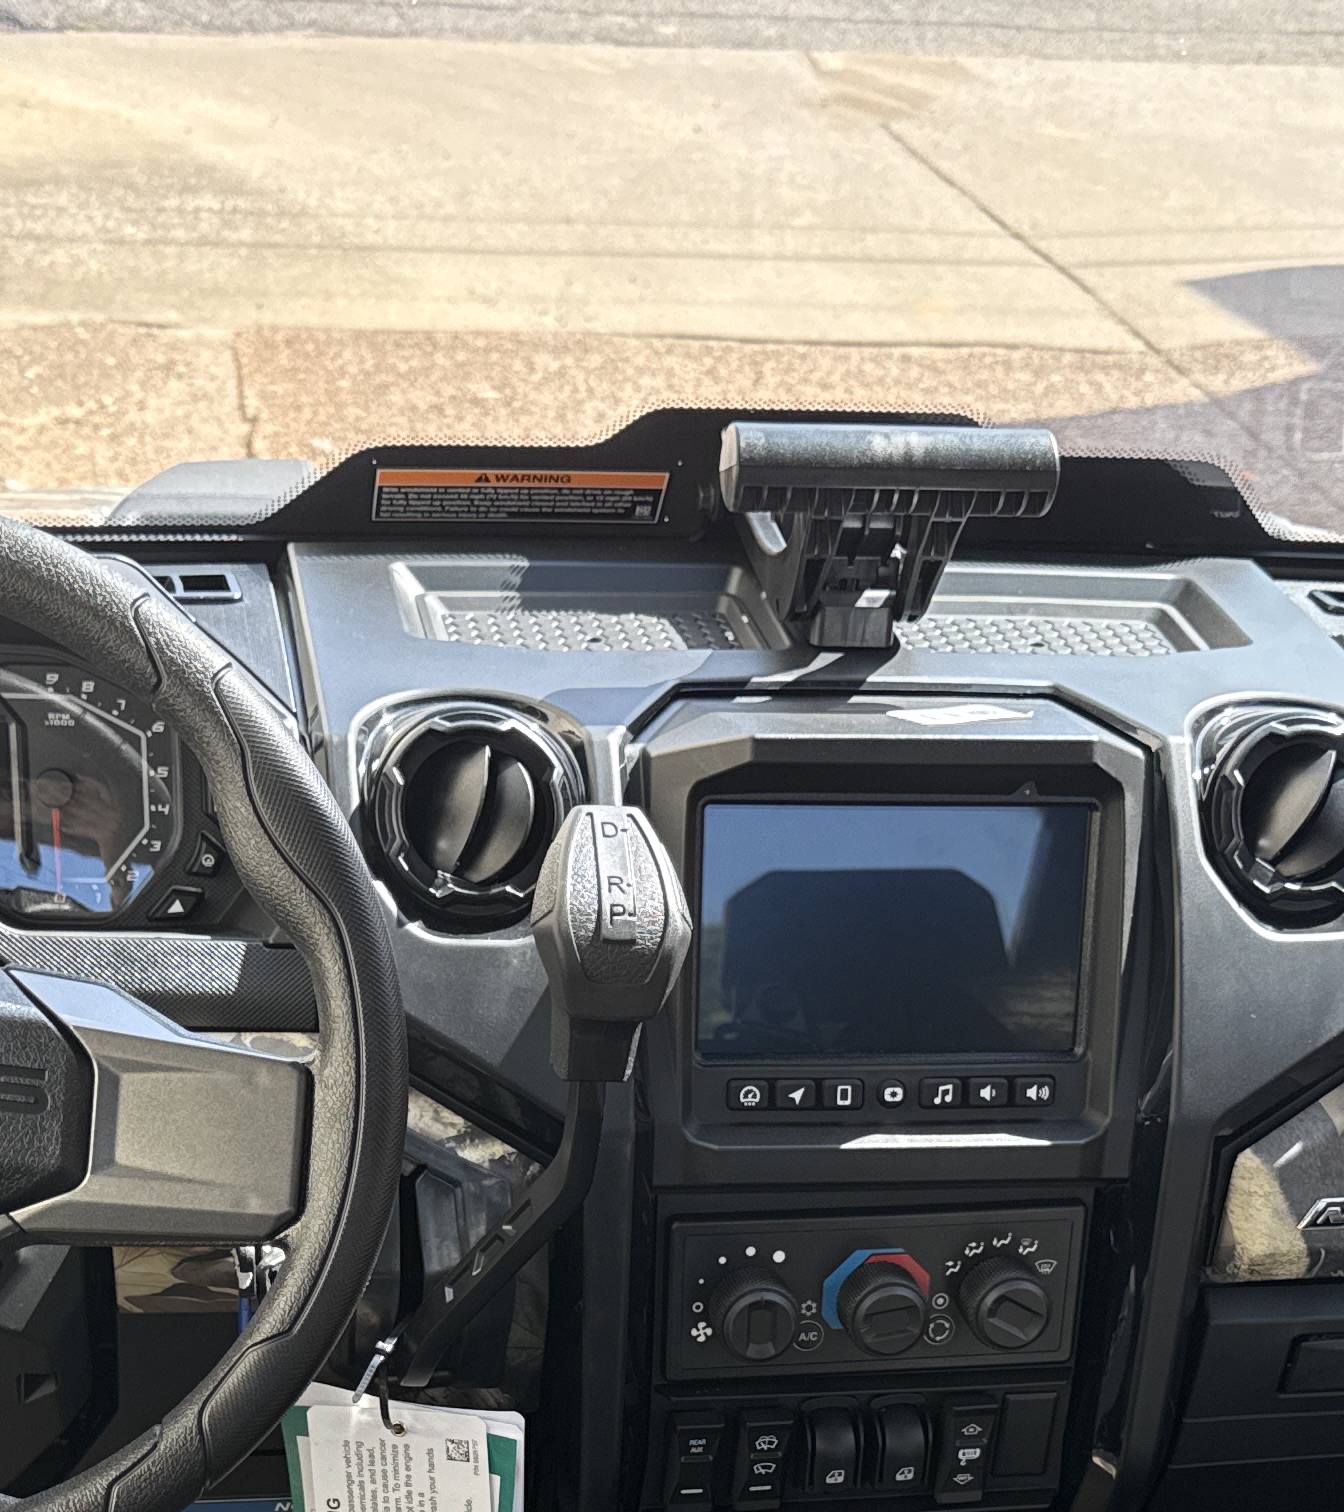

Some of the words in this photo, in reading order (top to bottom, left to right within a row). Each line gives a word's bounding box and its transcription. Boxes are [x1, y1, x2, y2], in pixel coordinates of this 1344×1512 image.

[494, 474, 571, 484] WARNING
[46, 673, 58, 684] 9
[82, 680, 95, 692] 8
[117, 699, 126, 710] 7
[47, 712, 70, 720] RPM
[152, 722, 165, 733] 6
[156, 766, 170, 778] 5
[158, 804, 170, 816] 4
[601, 822, 618, 838] D
[149, 840, 162, 852] 3
[127, 870, 140, 882] 2
[608, 876, 626, 894] R
[609, 904, 626, 928] P
[798, 1332, 818, 1342] A/C
[689, 1438, 706, 1446] REAR
[342, 1440, 351, 1468] vehicle
[379, 1438, 387, 1466] cancer
[690, 1446, 704, 1454] AUX
[355, 1441, 364, 1477] including
[391, 1444, 400, 1481] minimize
[403, 1444, 412, 1472] engine
[426, 1448, 435, 1473] hands
[368, 1469, 376, 1484] and
[381, 1469, 389, 1493] cause
[404, 1474, 412, 1487] the
[429, 1476, 438, 1494] your
[405, 1490, 413, 1504] idle
